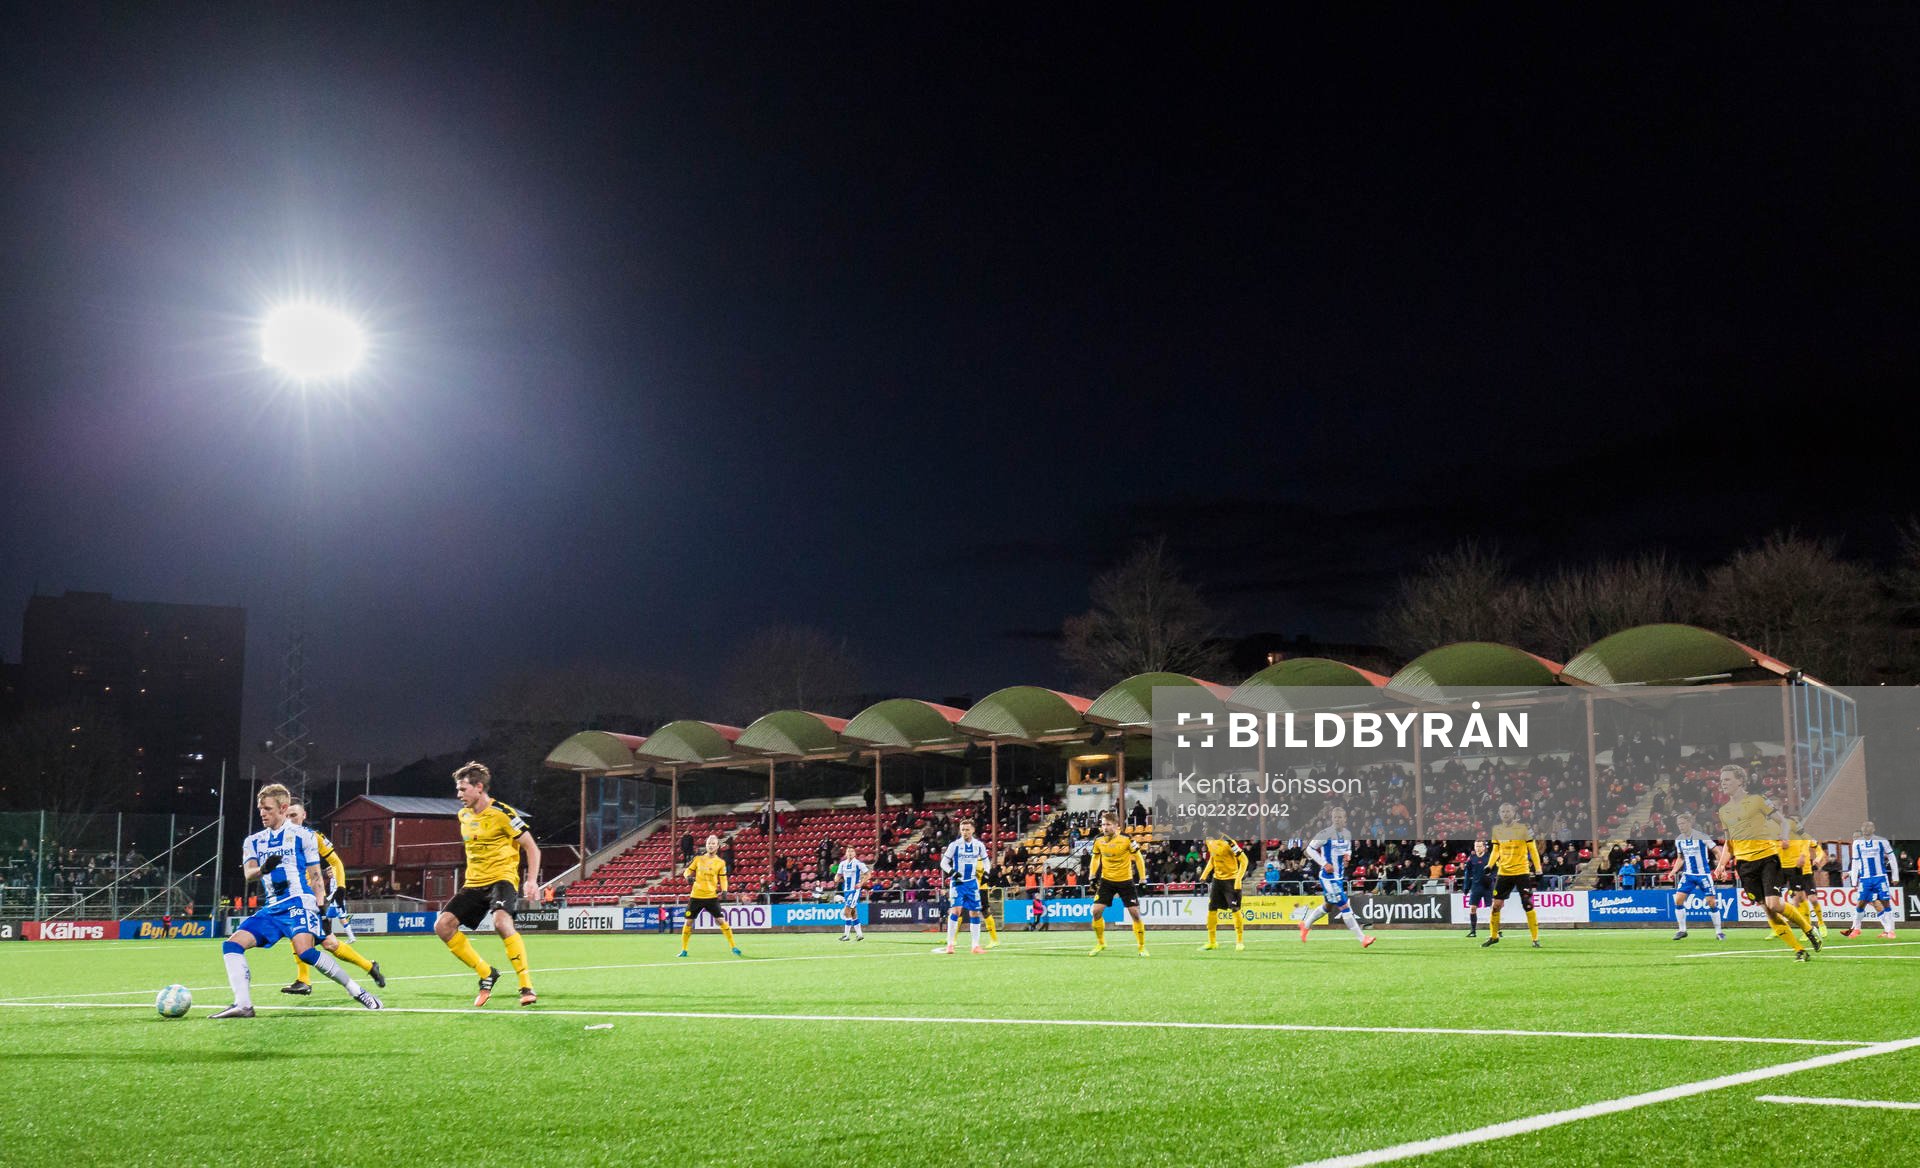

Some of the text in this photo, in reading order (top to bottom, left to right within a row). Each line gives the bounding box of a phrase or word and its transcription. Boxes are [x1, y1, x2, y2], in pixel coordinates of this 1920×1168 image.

[1532, 893, 1575, 908] EURO
[880, 908, 941, 919] SVENSKA CU
[1254, 911, 1283, 920] LINJEN
[1362, 897, 1443, 925] daymark
[1599, 906, 1658, 915] BYGGVAROR
[405, 916, 426, 928] FLIR
[568, 916, 613, 930] BOETTEN
[40, 922, 104, 940] Kährs
